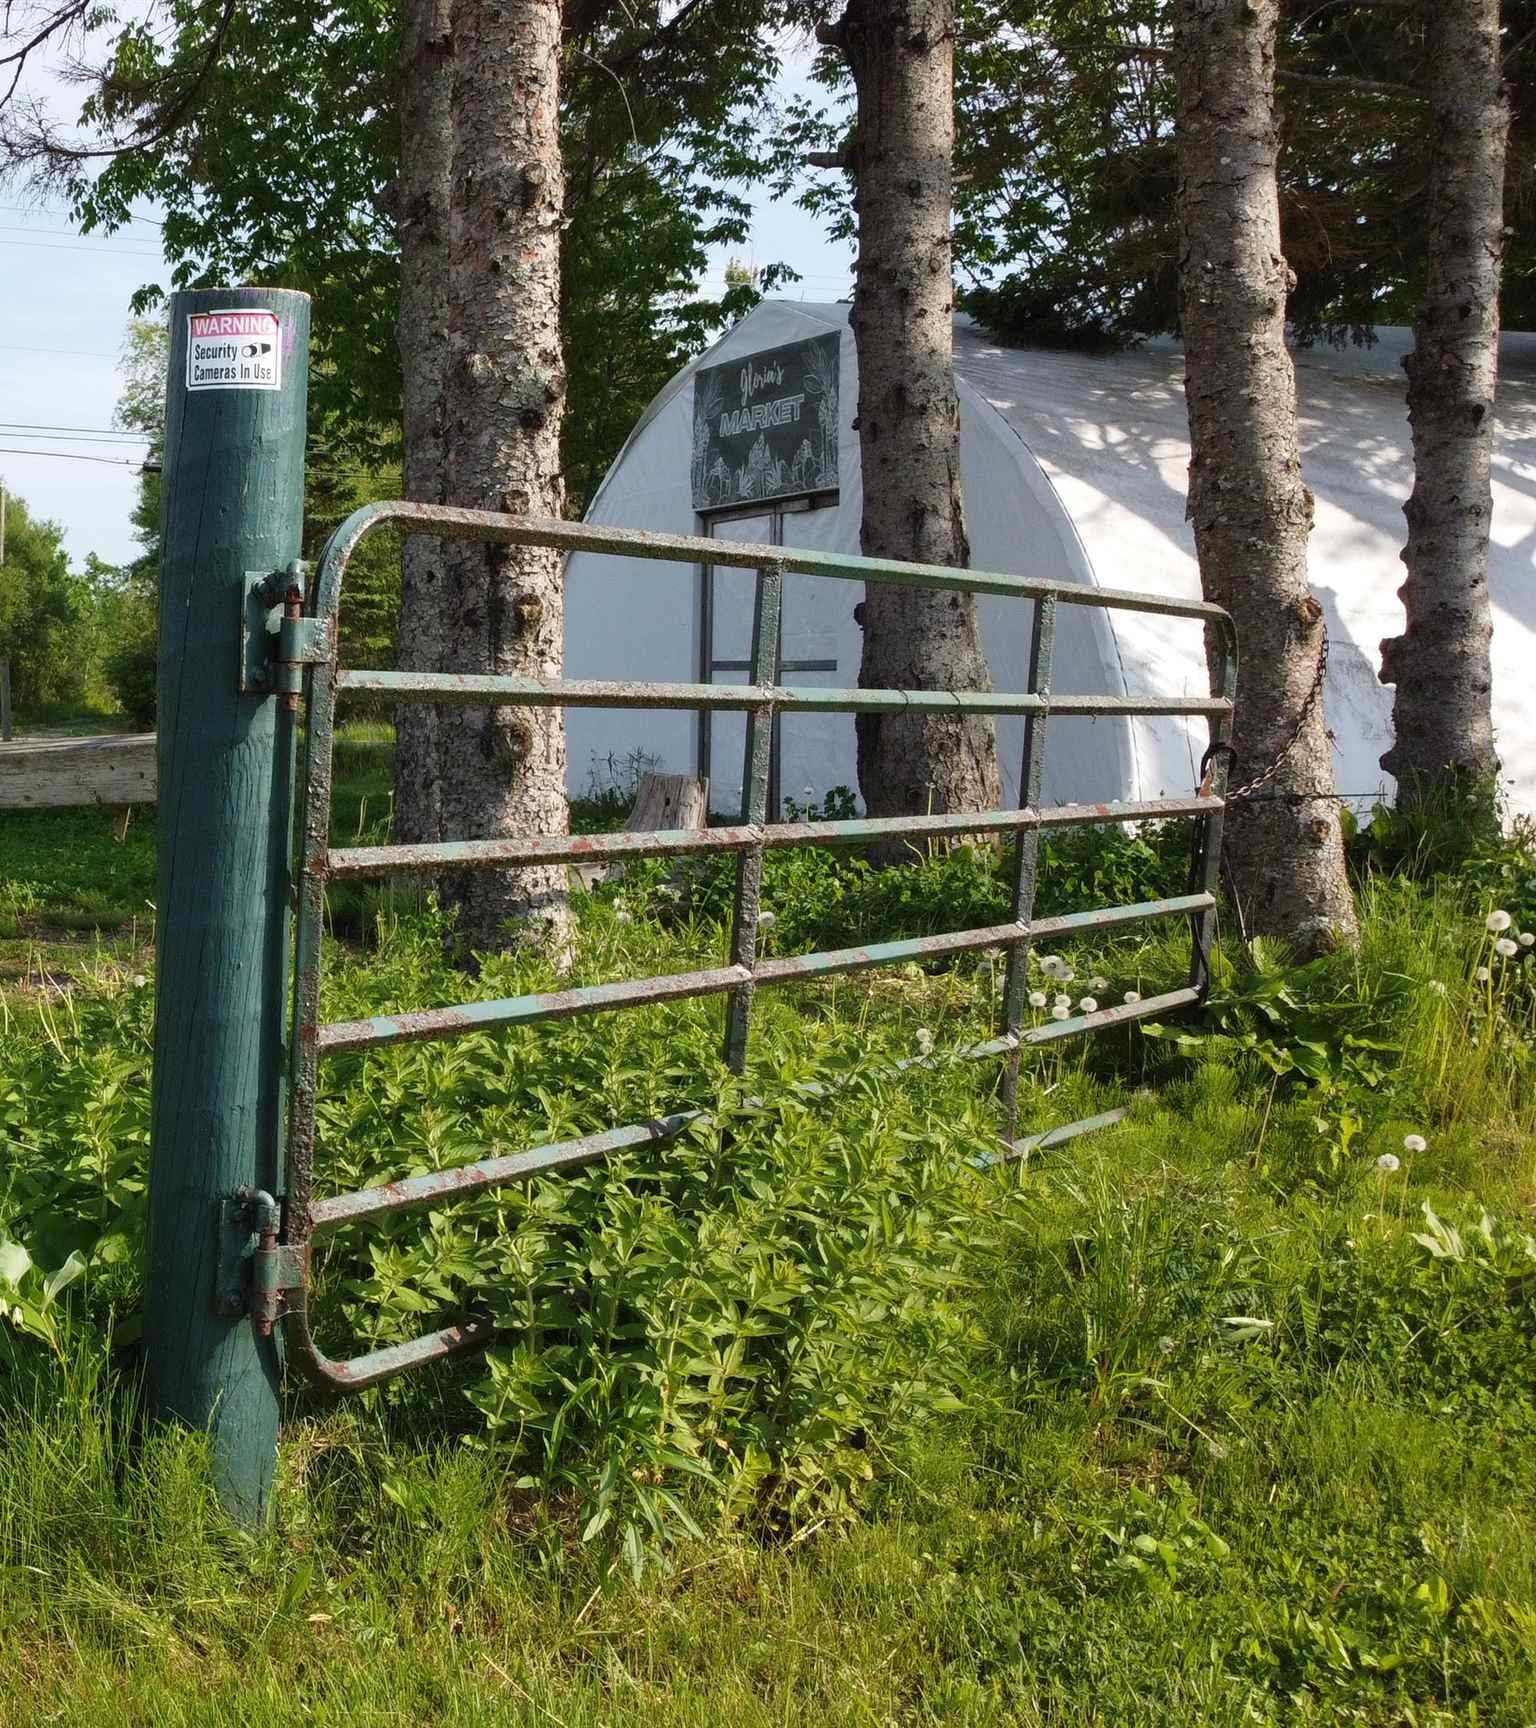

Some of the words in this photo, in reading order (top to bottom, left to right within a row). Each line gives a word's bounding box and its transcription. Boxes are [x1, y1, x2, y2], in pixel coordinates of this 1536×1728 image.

[195, 316, 275, 336] WARNING
[194, 342, 238, 361] Security
[194, 365, 237, 381] Cameras
[240, 363, 250, 379] In
[254, 363, 272, 380] Use
[720, 394, 805, 437] MARKET
